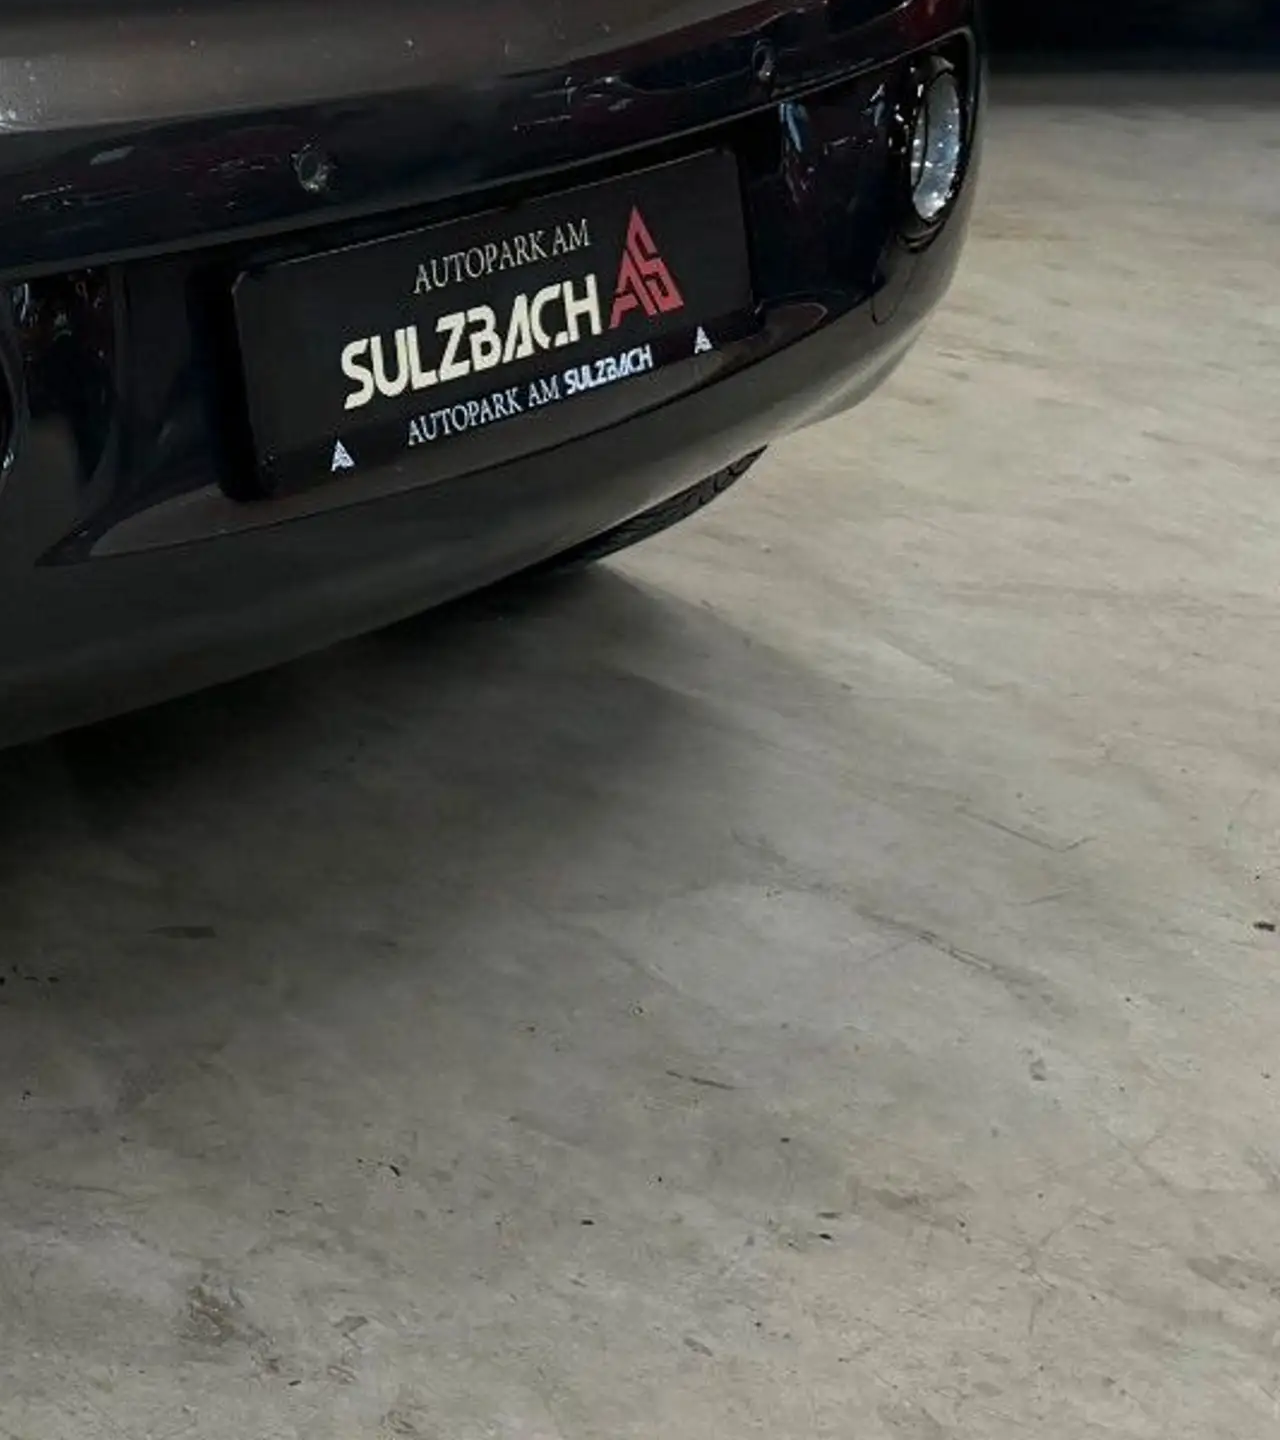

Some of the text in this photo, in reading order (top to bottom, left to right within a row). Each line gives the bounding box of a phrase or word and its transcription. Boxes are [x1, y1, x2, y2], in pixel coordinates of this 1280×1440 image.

[413, 218, 591, 295] AUTOPARK AM
[341, 273, 603, 410] SULZBACH
[407, 386, 524, 447] AUTOPARK
[527, 374, 562, 411] AM
[563, 344, 653, 396] SULZBACH
